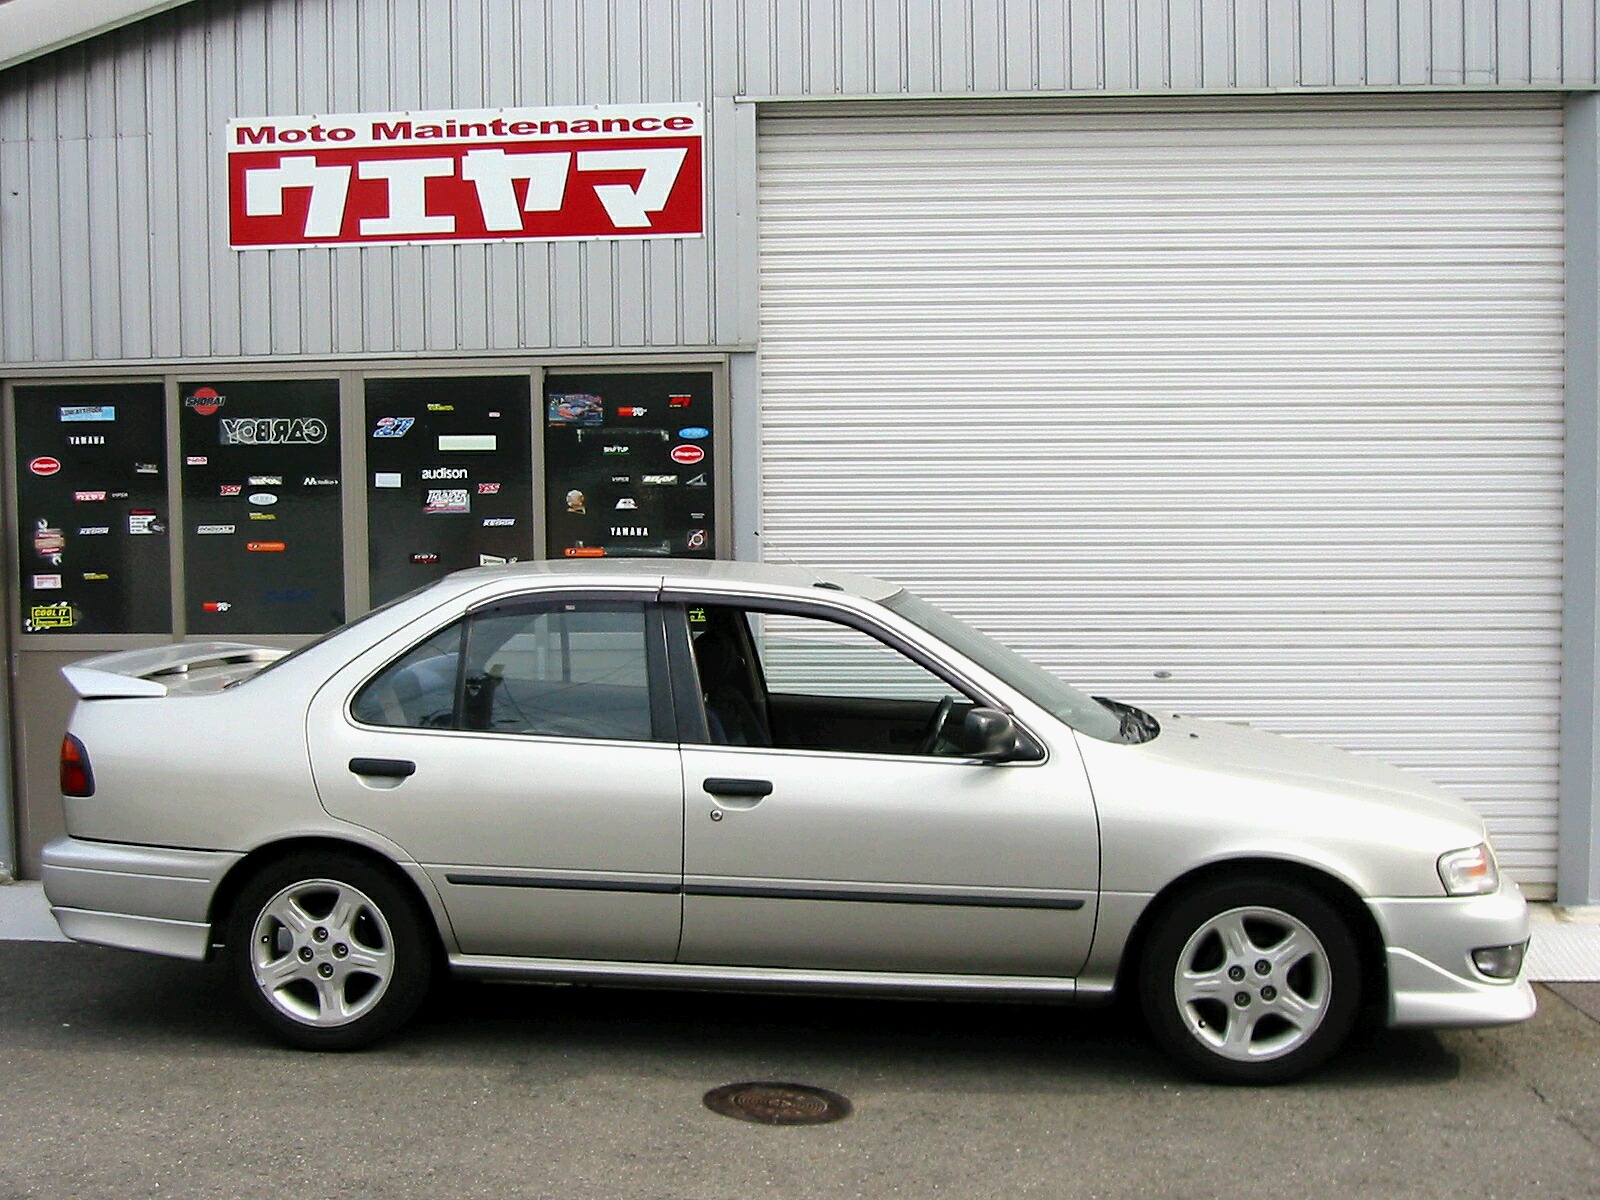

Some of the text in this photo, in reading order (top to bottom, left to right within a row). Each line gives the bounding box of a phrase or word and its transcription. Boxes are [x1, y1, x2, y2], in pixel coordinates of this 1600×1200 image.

[236, 115, 695, 145] Moto Maintenance
[245, 148, 689, 238] ウエヤマ
[373, 417, 416, 438] 27
[69, 436, 106, 445] YAMAHA
[421, 467, 469, 480] audison
[610, 527, 649, 536] YAMAHA
[34, 609, 68, 617] COOL IT
